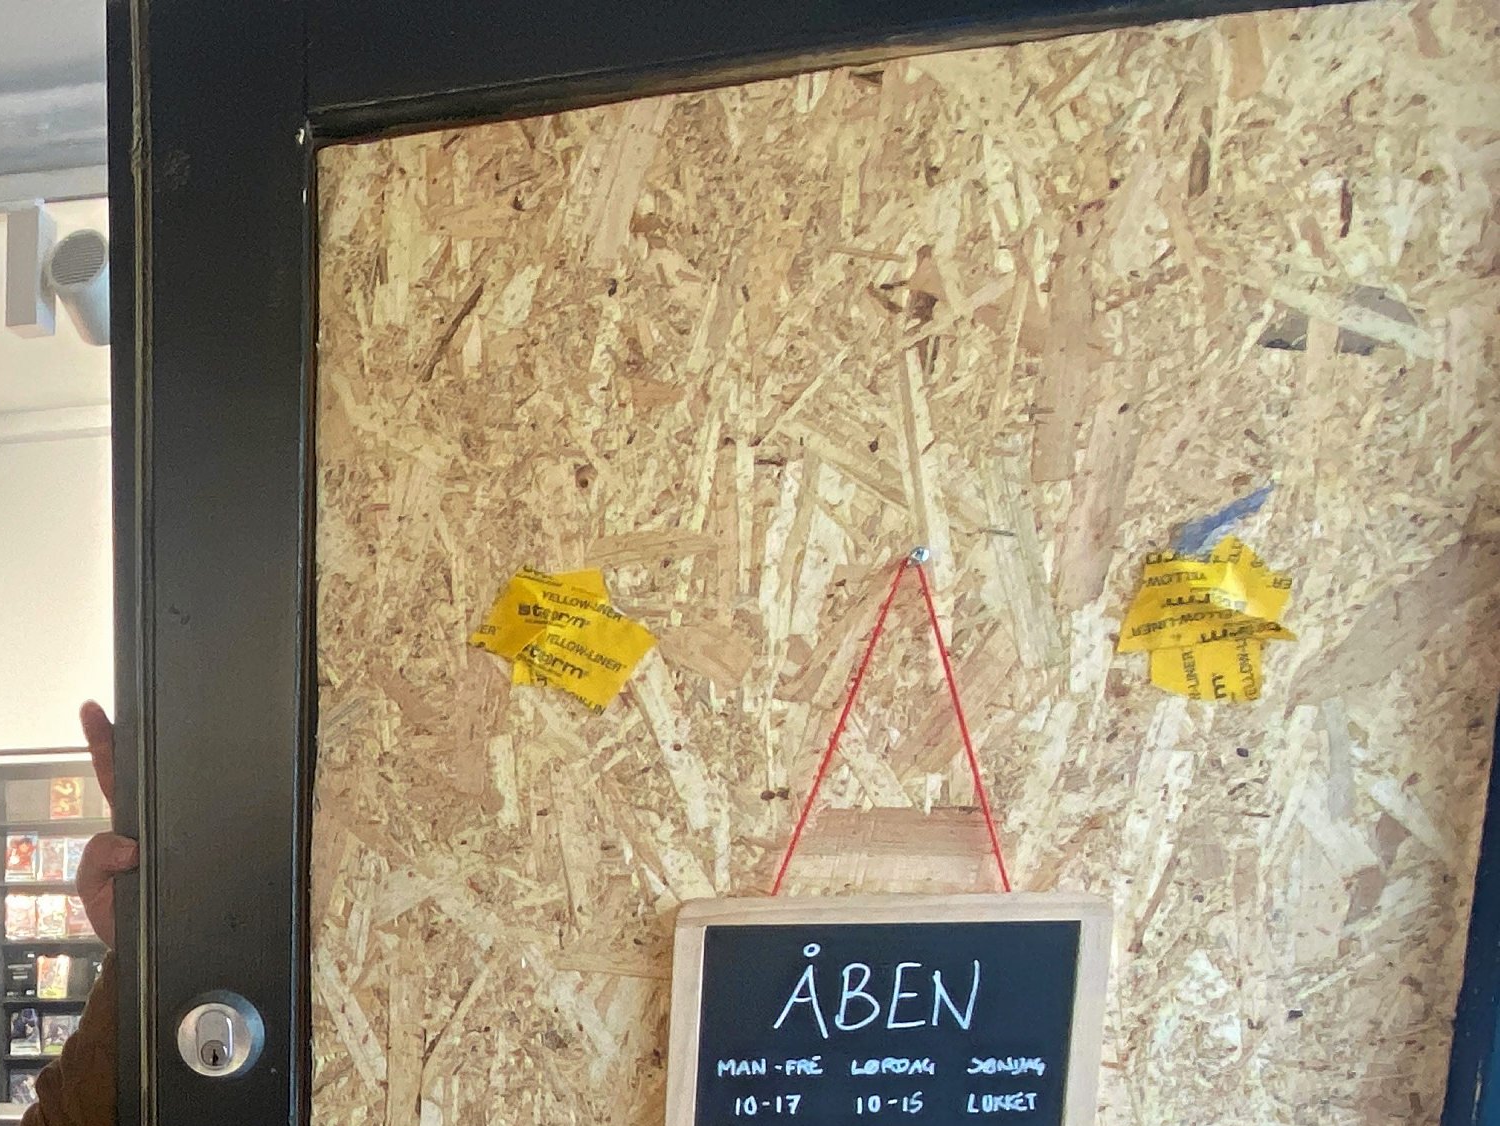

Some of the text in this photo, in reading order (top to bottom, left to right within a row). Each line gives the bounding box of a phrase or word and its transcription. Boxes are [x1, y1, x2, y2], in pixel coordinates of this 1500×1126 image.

[773, 942, 981, 1039] ÅBEN
[735, 1091, 1037, 1116] 10-17 10-15 LUKKET
